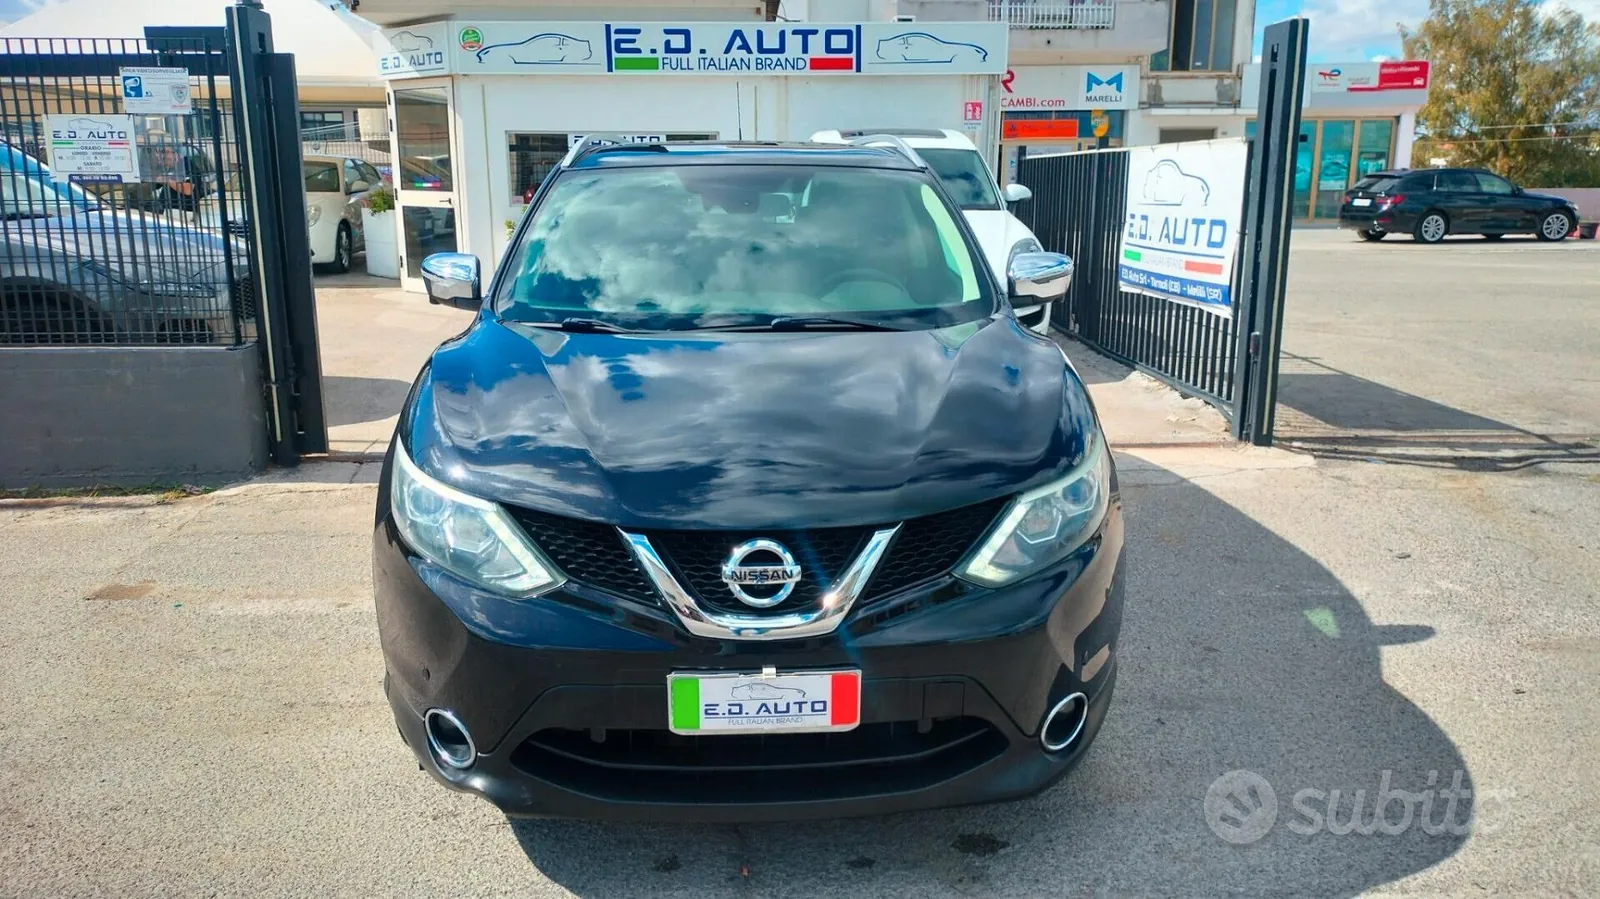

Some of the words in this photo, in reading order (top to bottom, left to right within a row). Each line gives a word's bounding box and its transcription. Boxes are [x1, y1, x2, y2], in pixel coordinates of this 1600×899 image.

[613, 28, 706, 55] E.D.
[723, 28, 854, 55] AUTO
[408, 51, 443, 67] AUTO
[661, 57, 694, 71] FULL
[698, 57, 751, 71] ITALIAN
[755, 57, 807, 71] BRAND
[1085, 95, 1122, 103] MARELLI
[87, 130, 127, 139] AUTO
[1158, 216, 1227, 249] AUTO
[731, 569, 793, 581] NISSAN
[704, 703, 749, 716] E.D.
[755, 700, 827, 716] AUTO
[728, 718, 745, 726] FULL
[746, 717, 774, 725] ITALIAN
[776, 717, 803, 725] BRAND
